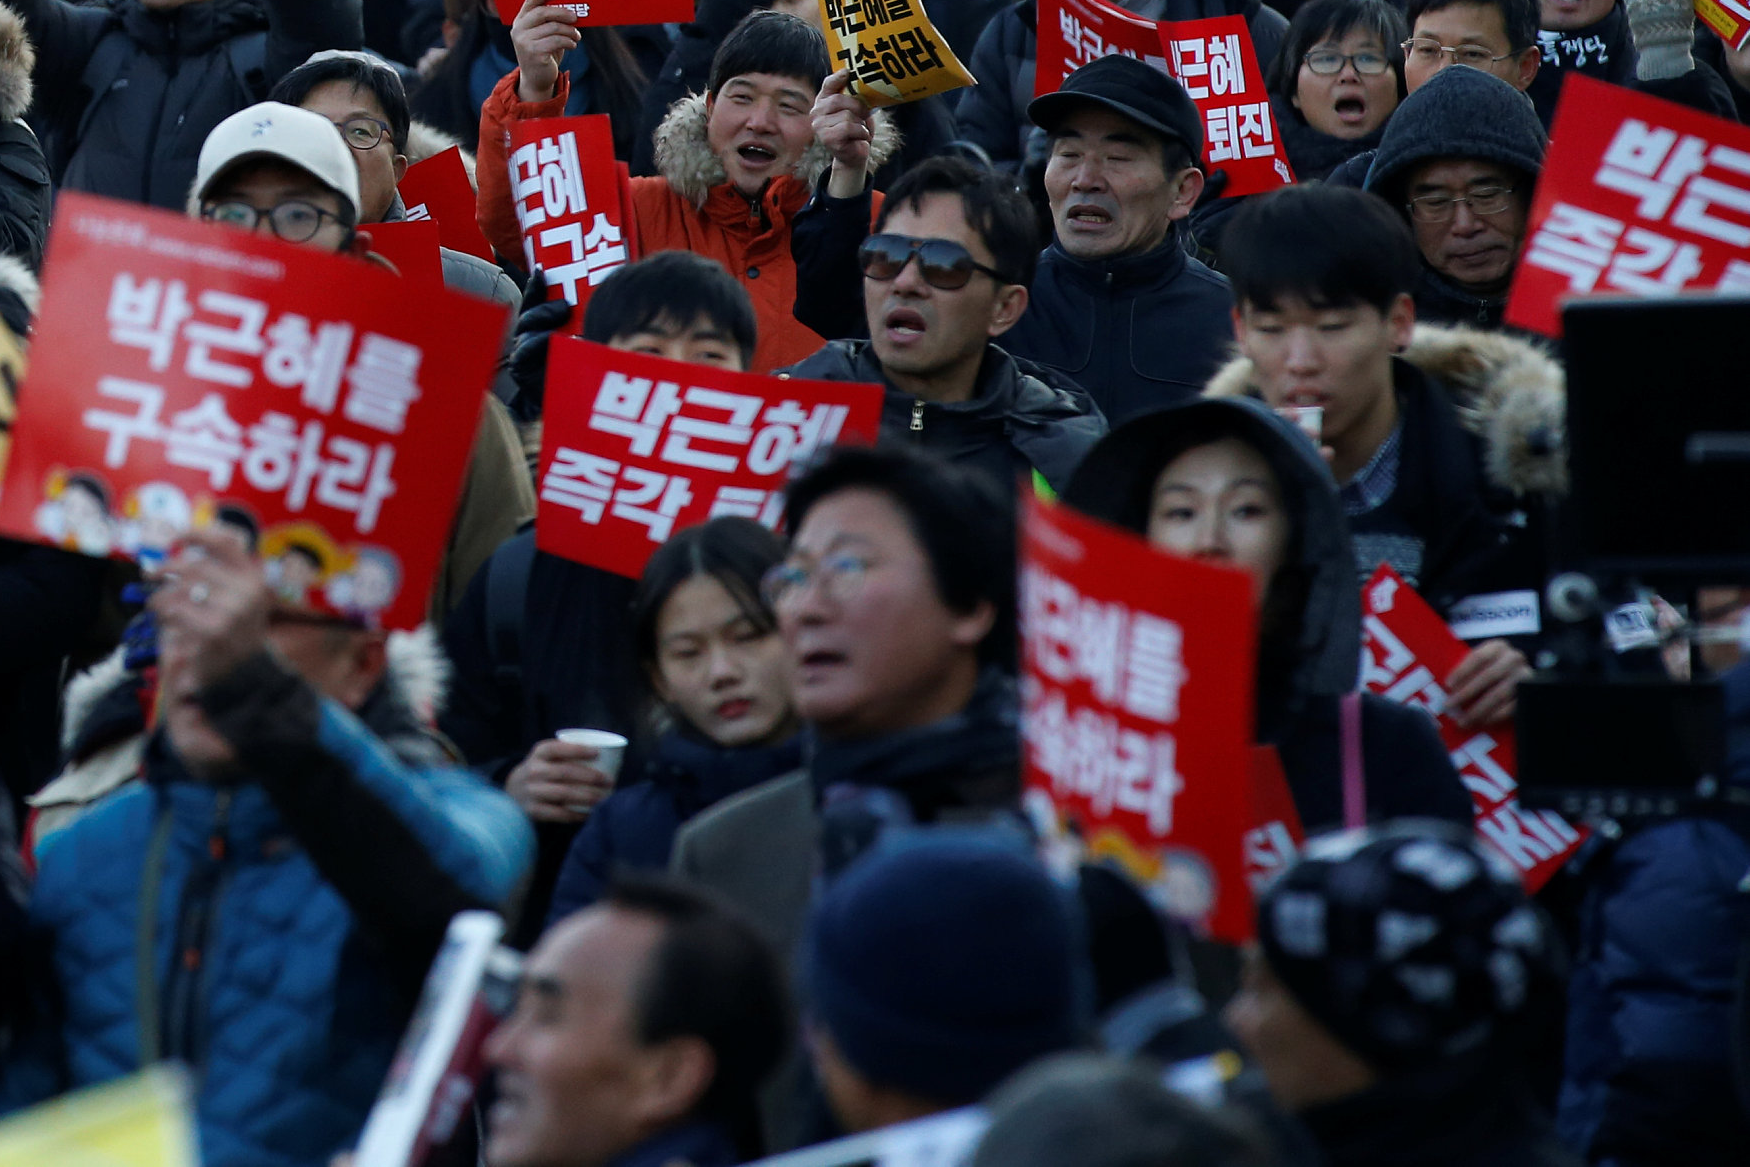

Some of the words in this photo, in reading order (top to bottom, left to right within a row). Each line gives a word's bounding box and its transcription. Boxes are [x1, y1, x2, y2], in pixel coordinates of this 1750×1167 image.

[837, 26, 945, 95] 구속하라
[1170, 33, 1247, 100] 근혜
[1205, 102, 1275, 164] 퇴진
[105, 272, 423, 435] 박근혜를
[82, 376, 396, 533] 구속하라
[587, 369, 850, 479] 박근혜
[540, 445, 695, 545] 즉각
